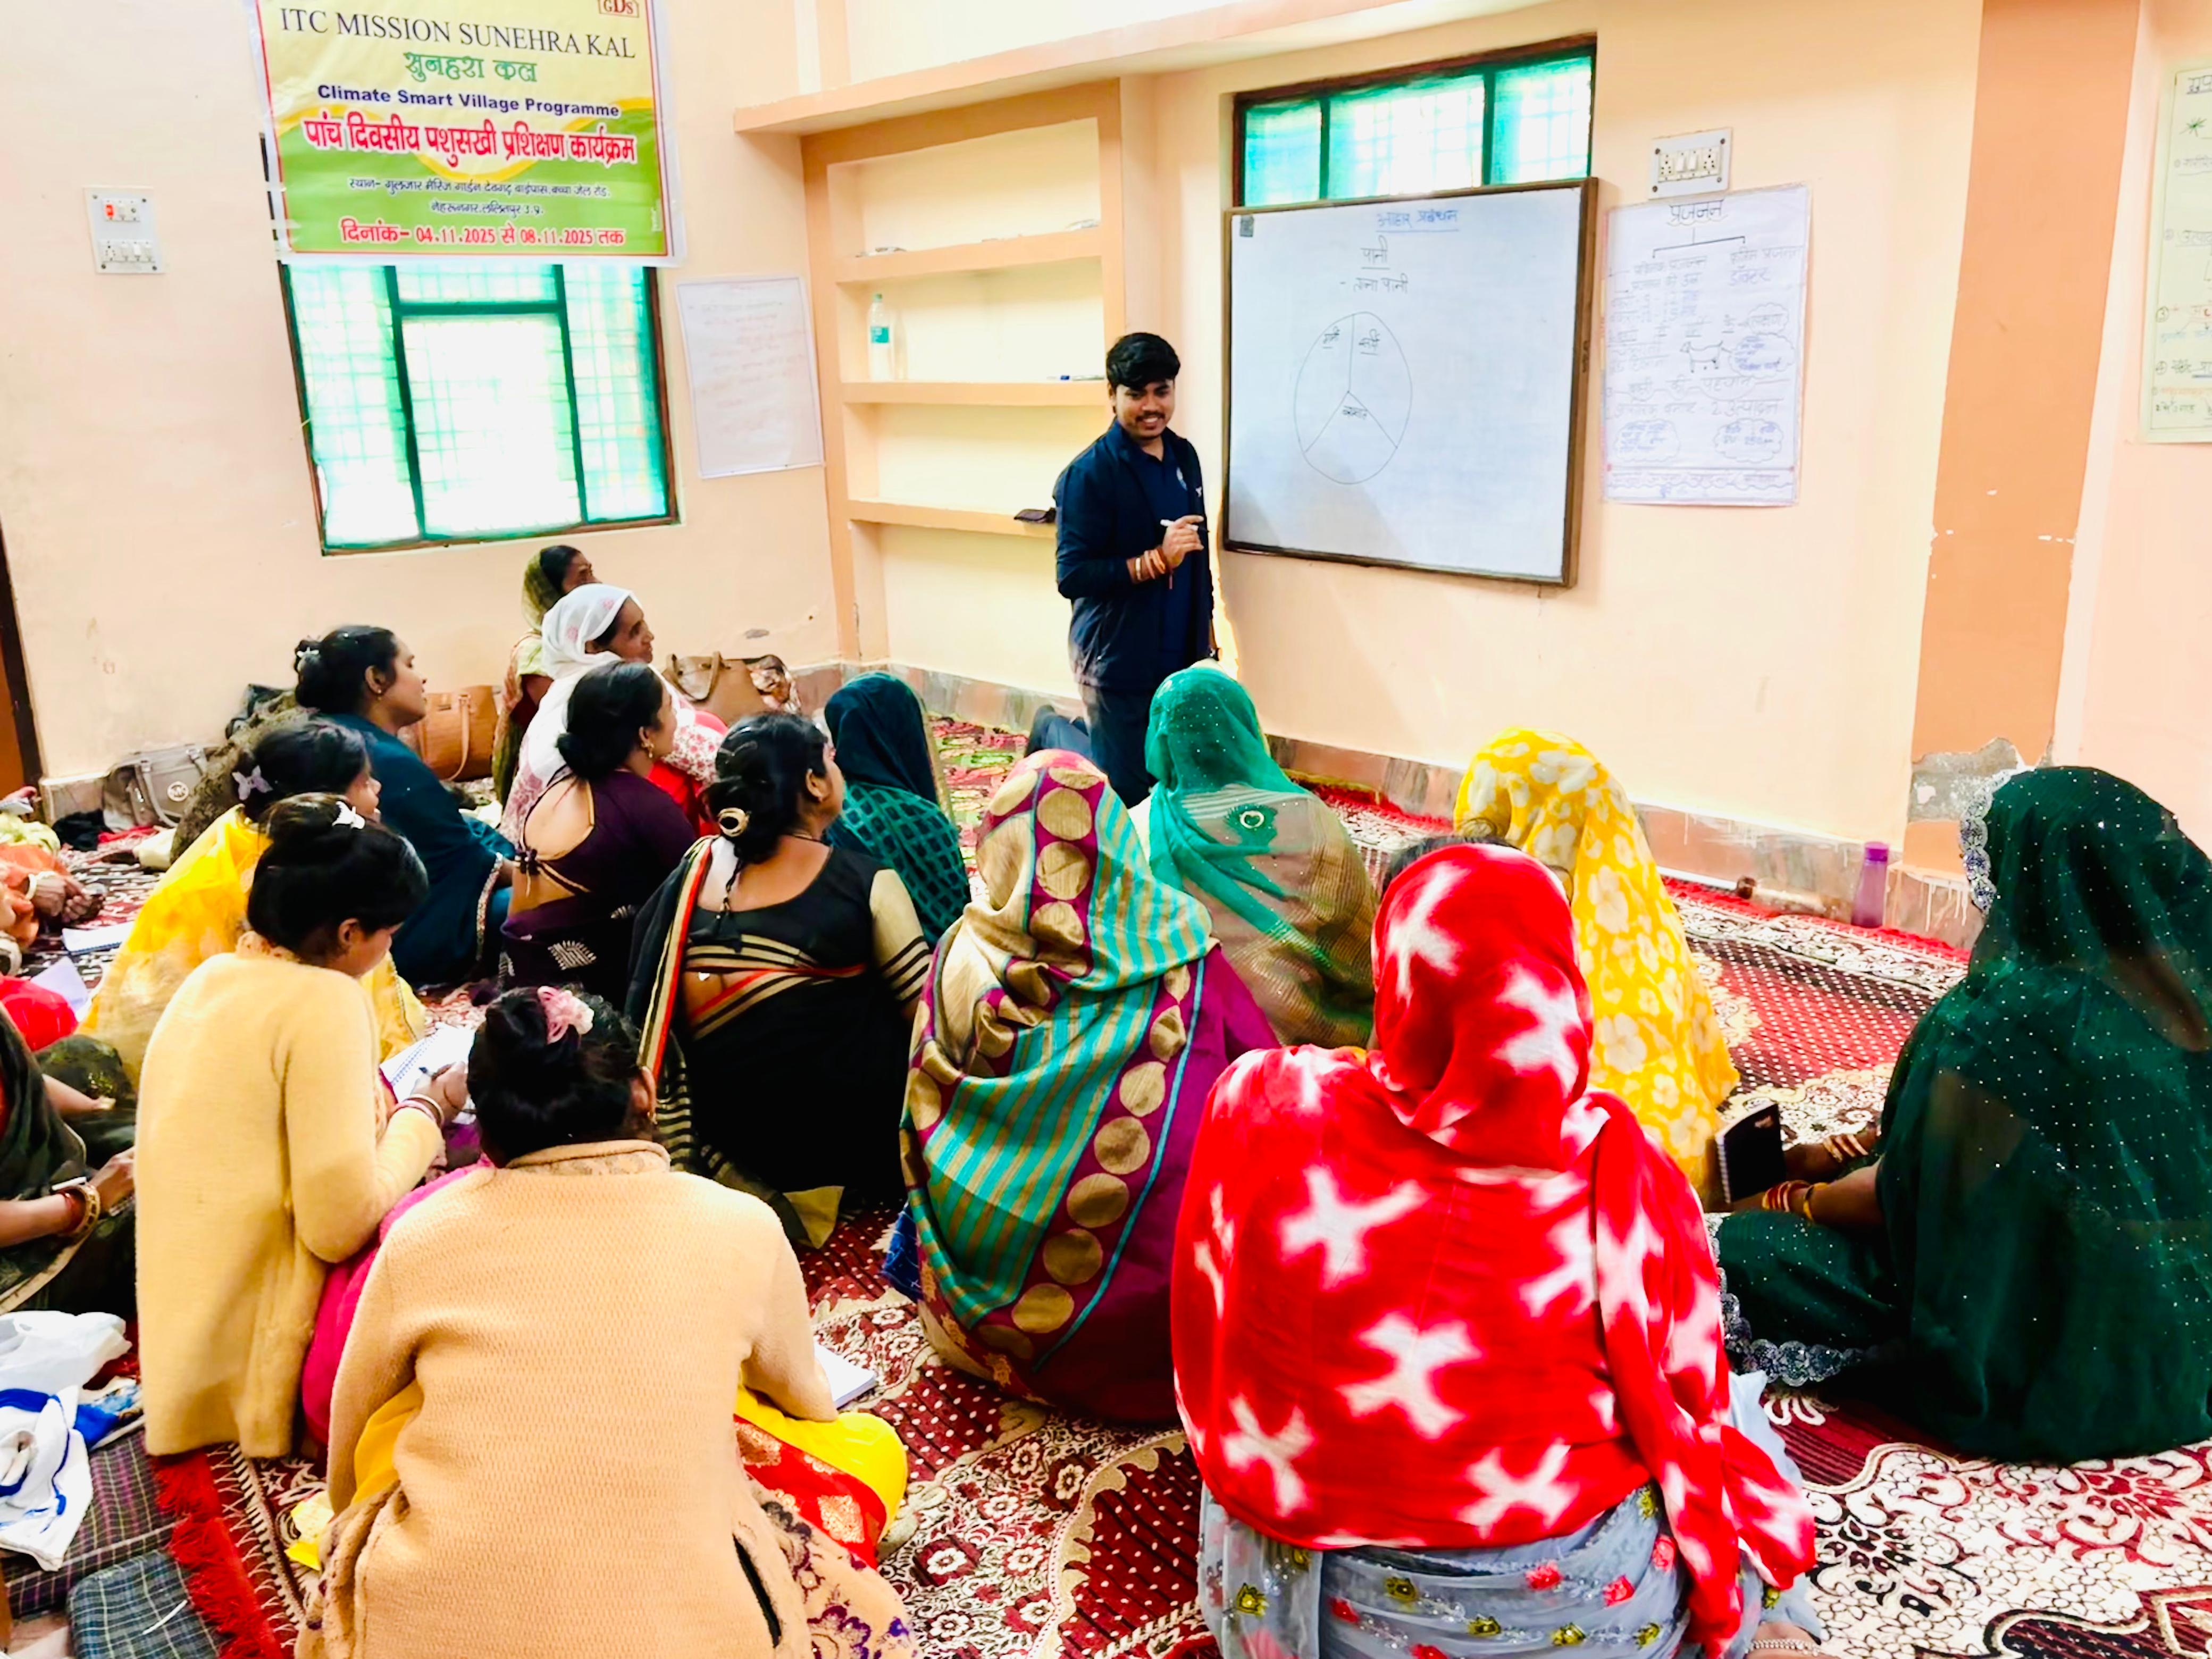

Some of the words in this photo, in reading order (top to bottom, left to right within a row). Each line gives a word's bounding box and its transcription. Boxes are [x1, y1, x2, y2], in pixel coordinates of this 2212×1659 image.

[280, 8, 328, 33] ITC
[336, 12, 450, 42] MISSION
[459, 23, 580, 54] SUNEHRA
[585, 34, 635, 58] KAL
[403, 52, 484, 82] सुनहरा
[492, 60, 538, 82] कल
[318, 85, 391, 102] Climate
[398, 90, 453, 106] Smart
[459, 94, 519, 113] Village
[525, 98, 619, 116] Programme
[304, 111, 342, 147] पांच
[347, 111, 421, 150] दिवसीय
[424, 119, 497, 167] पशुसखी
[502, 121, 565, 160] प्रशिक्षण
[568, 125, 635, 164] कार्यक्रम
[1670, 199, 1724, 221] प्रजनन
[416, 227, 495, 244] 04.11.2025
[501, 223, 515, 244] से
[521, 229, 593, 244] 08.11.2025
[597, 230, 624, 244] तक
[1360, 235, 1388, 263] पानी
[1381, 273, 1408, 294] पानी
